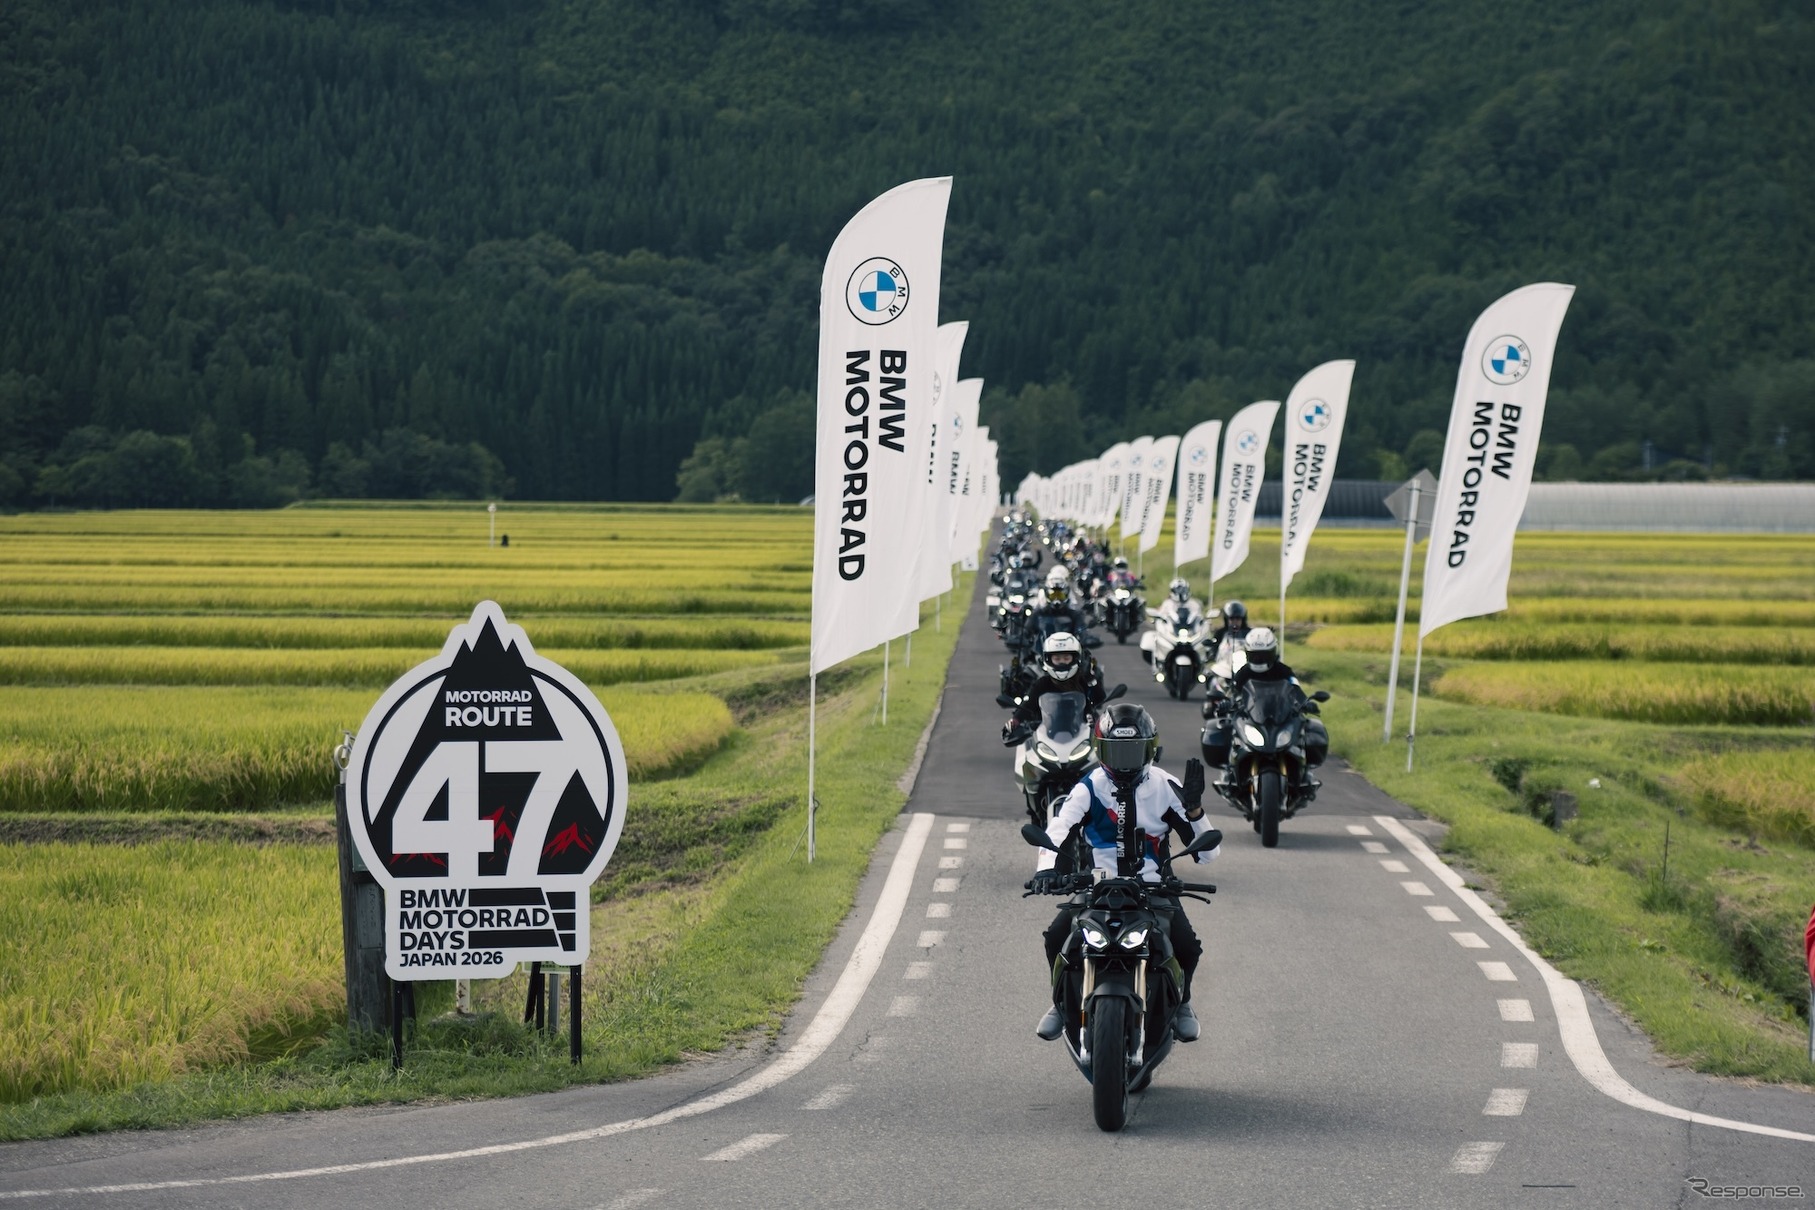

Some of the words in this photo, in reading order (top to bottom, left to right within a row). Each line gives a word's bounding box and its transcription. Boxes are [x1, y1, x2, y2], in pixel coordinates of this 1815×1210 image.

[878, 349, 907, 453] BMW
[1491, 403, 1522, 480] BMW
[838, 349, 870, 582] MOTORRAD
[1241, 464, 1255, 503] BMW
[1307, 443, 1327, 492] BMW
[1447, 402, 1494, 569] MOTORRAD
[1223, 463, 1242, 550] MOTORRAD
[445, 690, 533, 703] MOTORRAD
[445, 706, 533, 727] ROUTE
[391, 740, 564, 878] 47
[400, 888, 467, 909] BMW
[400, 908, 550, 930] MOTORRAD
[400, 930, 465, 951] DAYS
[400, 952, 457, 967] JAPAN
[461, 951, 504, 966] 2026
